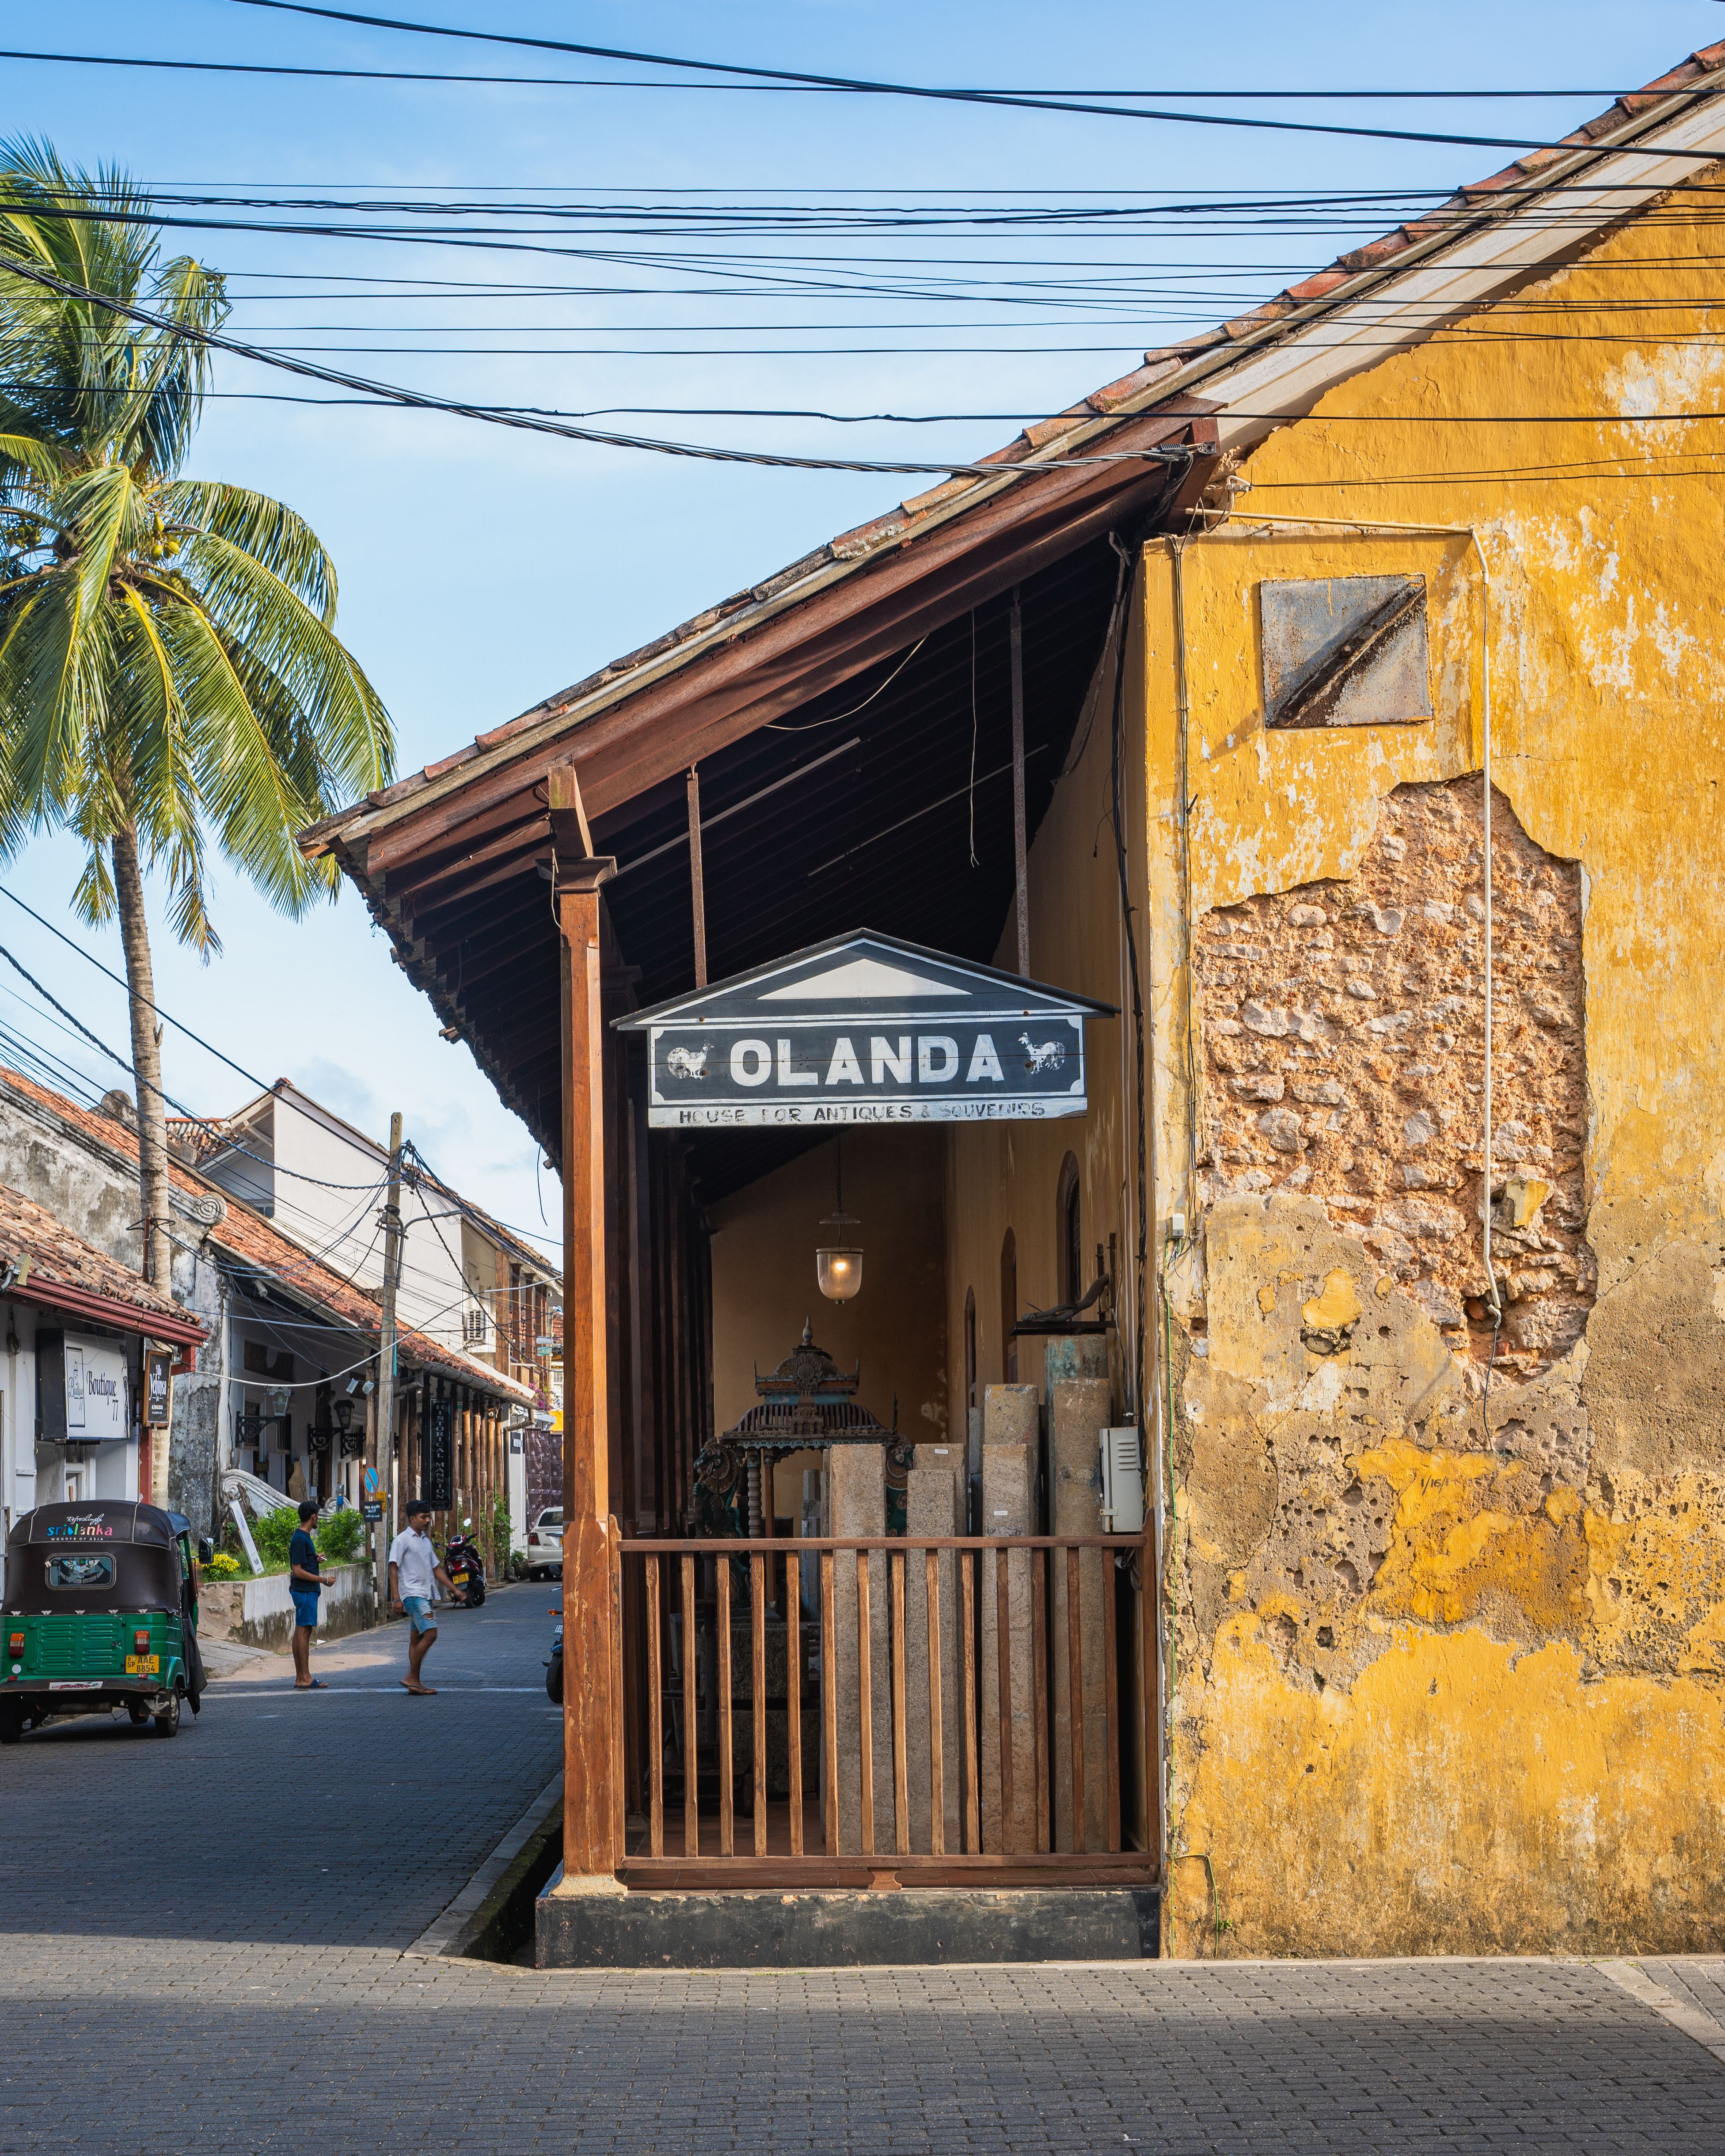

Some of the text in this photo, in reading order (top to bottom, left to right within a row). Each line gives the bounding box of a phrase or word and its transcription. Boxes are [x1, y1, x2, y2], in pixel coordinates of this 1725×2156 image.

[730, 1034, 1005, 1086] OLANDA
[680, 1109, 747, 1124] HOUSE
[762, 1108, 802, 1123] FOR
[813, 1105, 913, 1121] ANTIQUES
[920, 1105, 931, 1119] &
[87, 1370, 117, 1406] Boutique
[112, 1399, 119, 1421] 77
[436, 1405, 445, 1458] HISTORICAL
[435, 1462, 445, 1499] MANSION
[66, 1513, 104, 1525] Refreshingly
